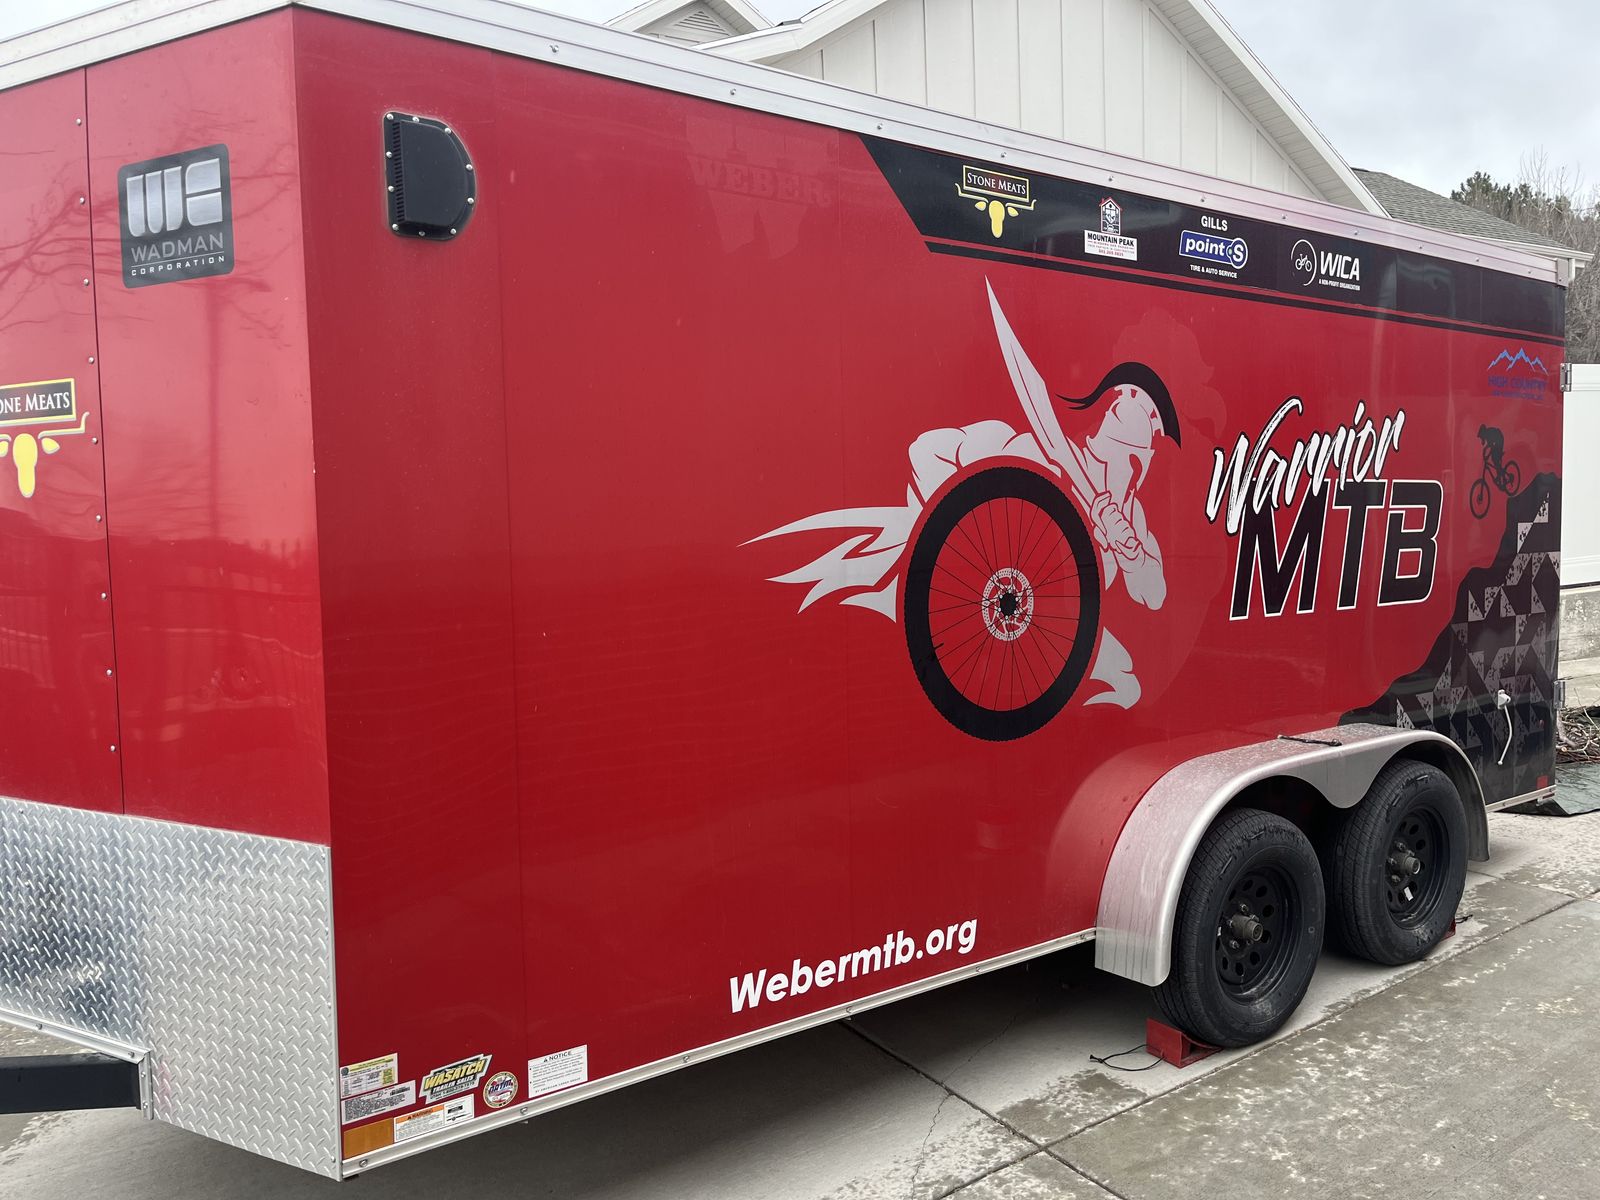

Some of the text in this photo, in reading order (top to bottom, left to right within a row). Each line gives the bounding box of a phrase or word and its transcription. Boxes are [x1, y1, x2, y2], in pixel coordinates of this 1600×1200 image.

[967, 172, 1026, 195] STONE MEATS
[1201, 215, 1228, 232] GILLS
[131, 232, 224, 263] WADMAN
[1087, 232, 1118, 245] MOUNTAIN
[1118, 238, 1135, 247] PEAK
[131, 255, 225, 276] CORPORATION
[1190, 264, 1201, 273] TIRE
[1218, 269, 1238, 279] SERVICE
[1320, 250, 1361, 281] WICA
[25, 391, 71, 412] MEATS
[1205, 396, 1406, 536] Warrior
[1229, 477, 1444, 621] MTB
[730, 918, 977, 1013] Webermtb.org
[424, 1059, 486, 1090] WASATCH
